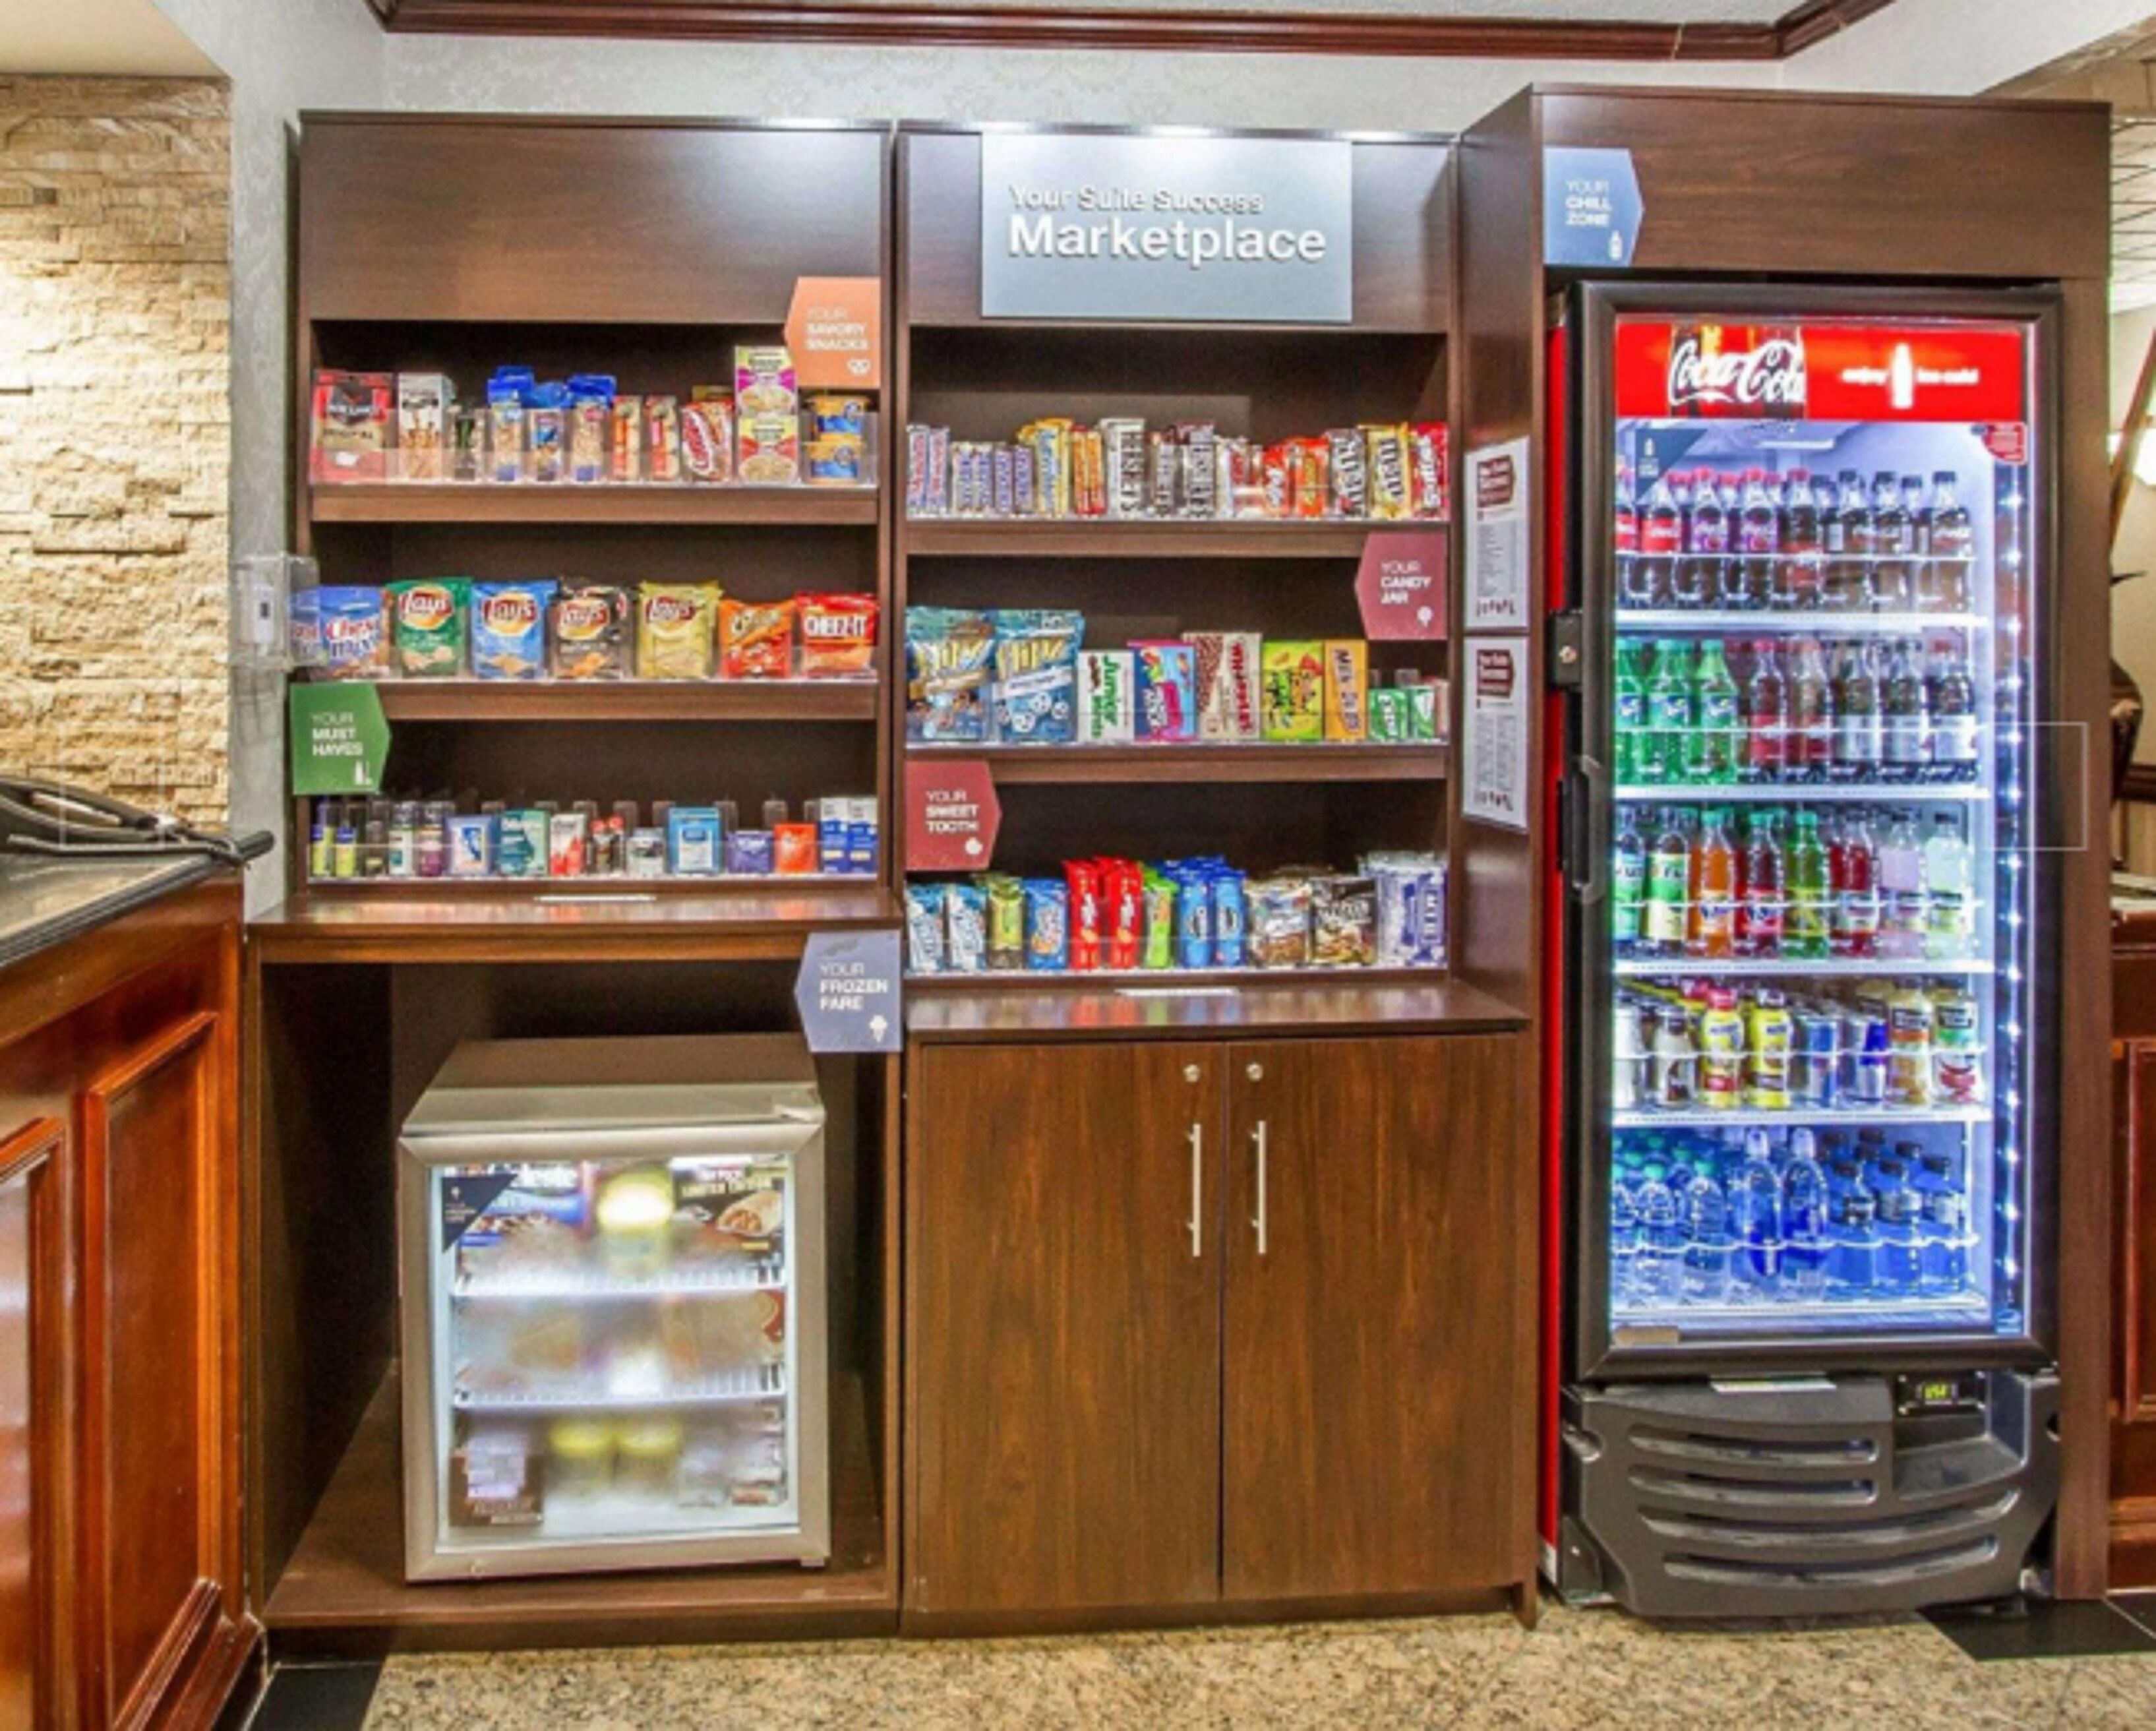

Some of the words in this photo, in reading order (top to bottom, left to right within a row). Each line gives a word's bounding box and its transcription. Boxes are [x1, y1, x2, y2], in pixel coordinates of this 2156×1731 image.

[1009, 183, 1069, 210] Your
[1078, 185, 1146, 212] Suite
[1153, 188, 1265, 215] Success
[1007, 214, 1327, 269] Marketplace
[1380, 561, 1421, 574] YOUR
[1380, 576, 1432, 589] CANDY
[1380, 592, 1409, 604] JAR
[311, 712, 354, 724] YOUR
[312, 727, 356, 740] MUST
[312, 743, 363, 756] HAVES
[926, 790, 967, 803] YOUR
[926, 805, 979, 818] SWEET
[926, 820, 978, 833] TOOTH
[820, 962, 864, 976] YOUR
[820, 979, 888, 993] FROZEN
[820, 995, 864, 1010] FARE
